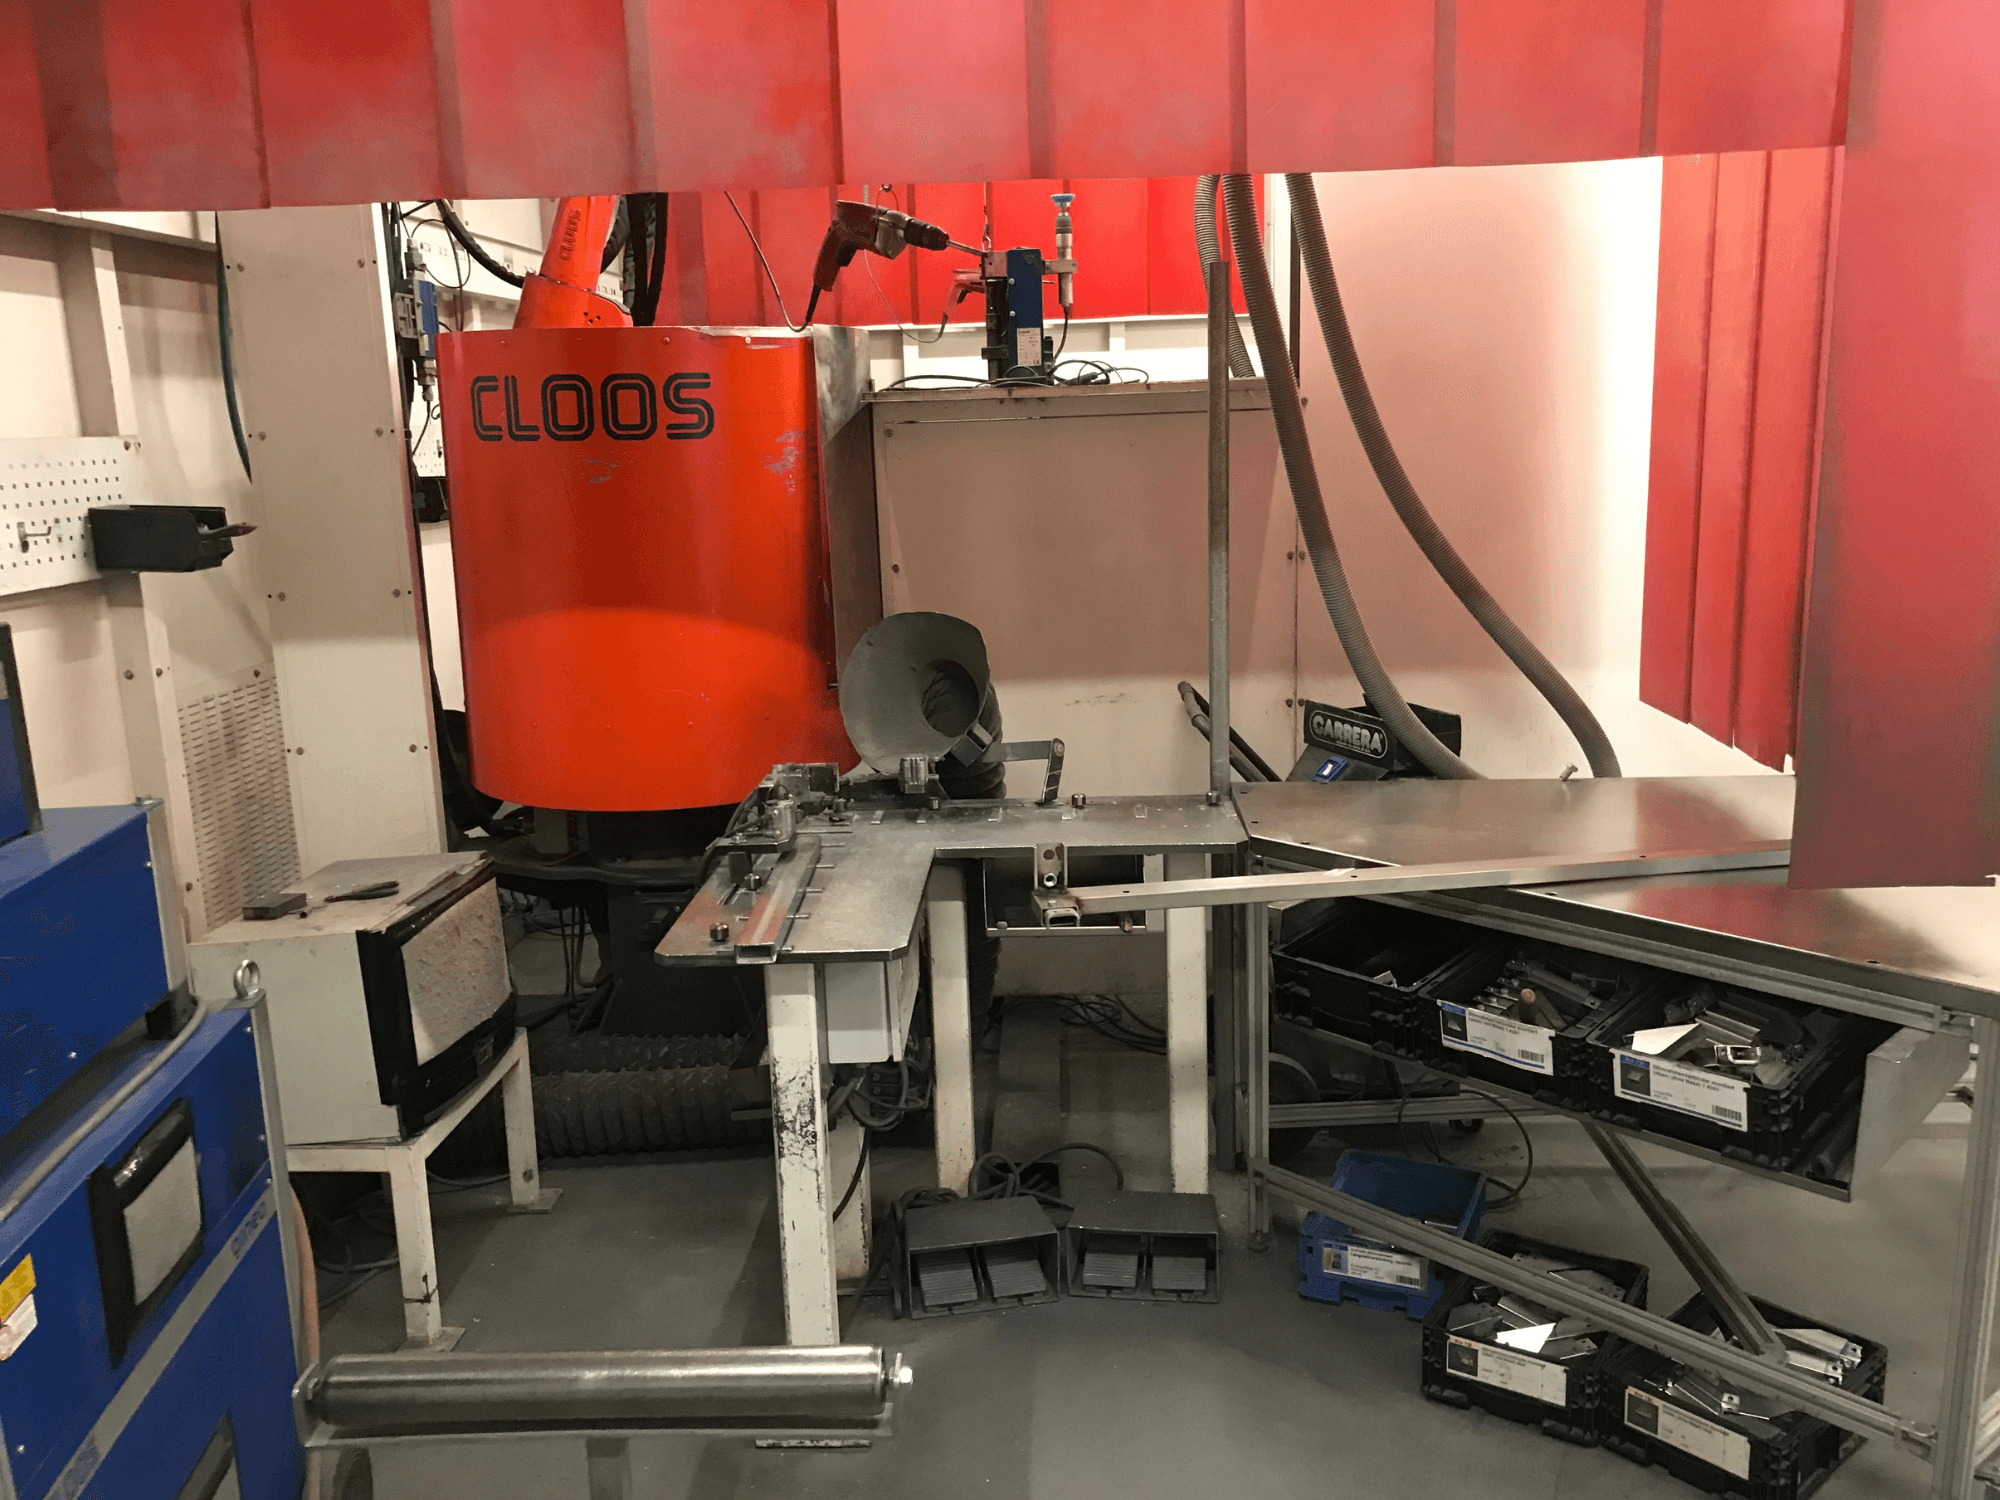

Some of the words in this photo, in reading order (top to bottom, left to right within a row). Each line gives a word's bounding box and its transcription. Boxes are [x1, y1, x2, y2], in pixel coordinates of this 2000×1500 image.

[559, 208, 581, 260] CLOOS
[470, 372, 715, 442] CLOOS
[1312, 715, 1382, 753] CARRERA
